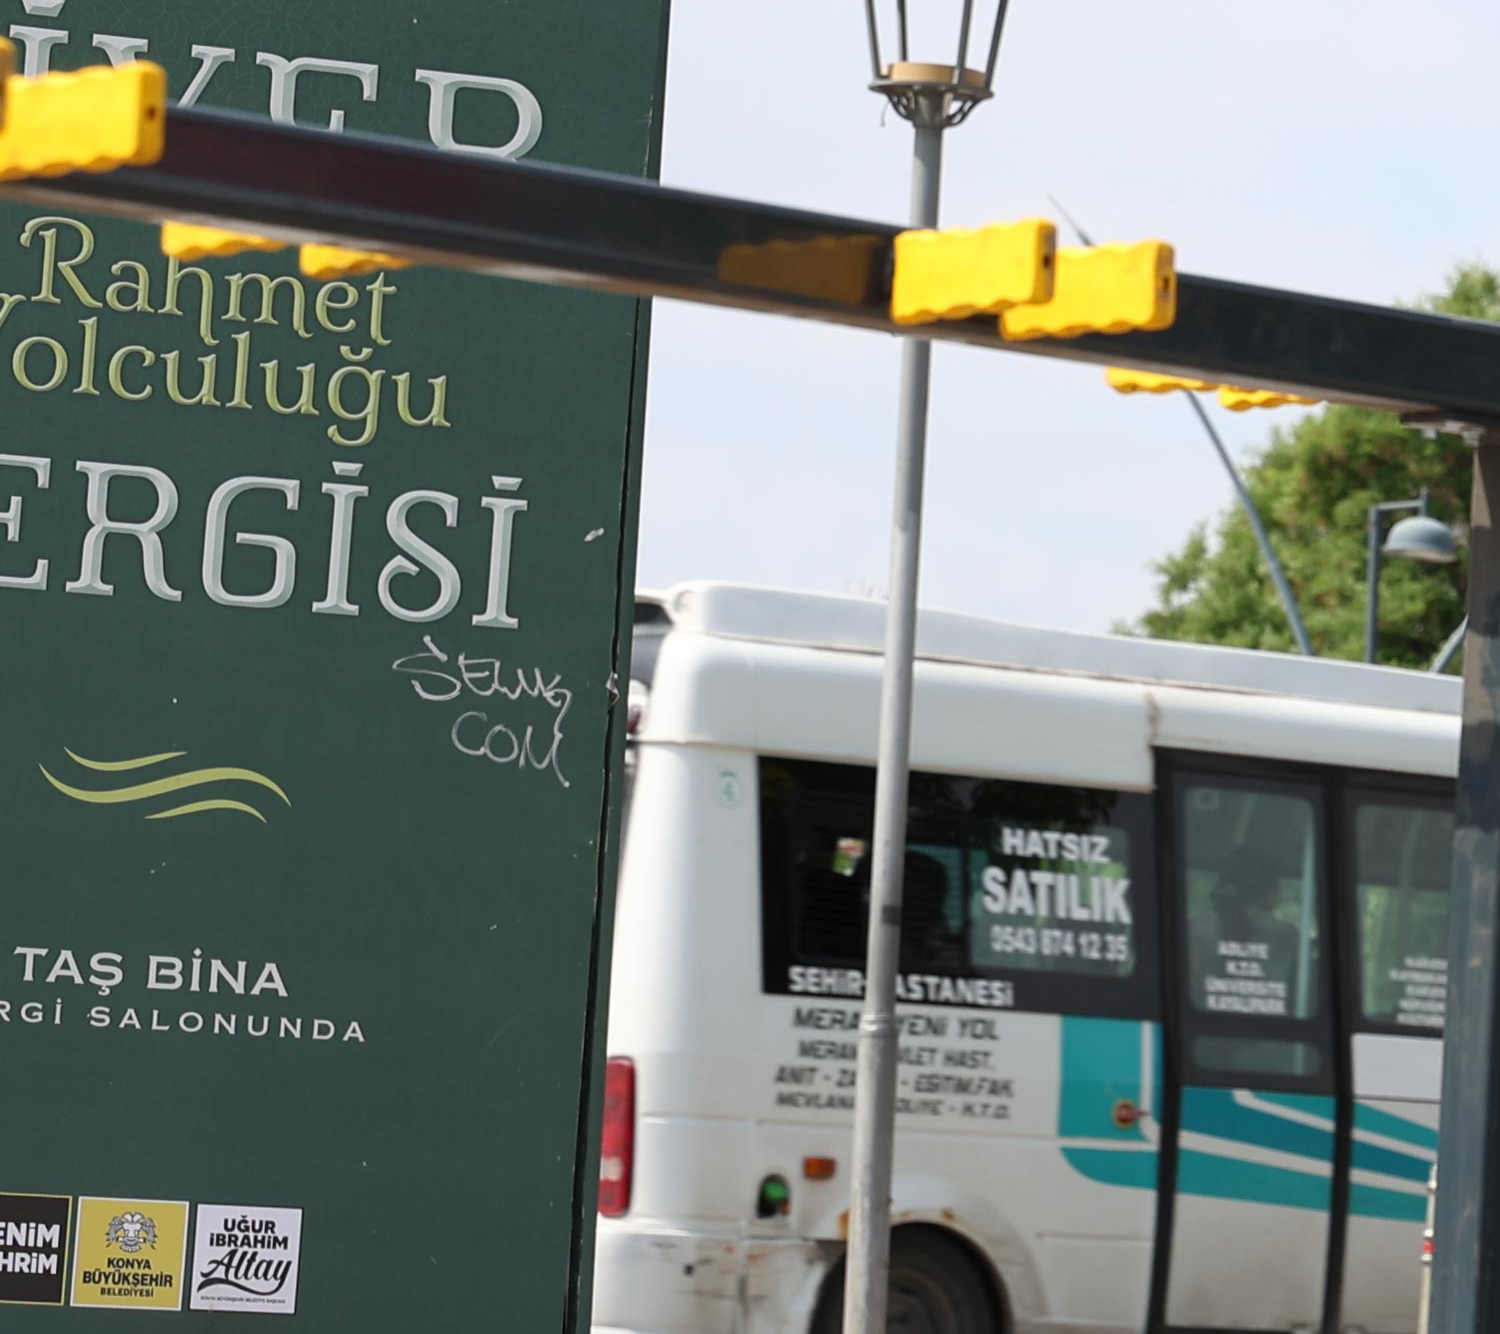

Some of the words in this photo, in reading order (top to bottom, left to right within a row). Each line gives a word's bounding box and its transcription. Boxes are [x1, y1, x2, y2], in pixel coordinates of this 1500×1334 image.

[20, 216, 397, 345] Rahmet
[981, 866, 1132, 924] SATILIK
[13, 946, 124, 996] TAŞ
[147, 947, 288, 997] BİNA
[89, 1005, 365, 1042] SALONUNDA
[223, 1214, 276, 1234] UĞUR
[209, 1232, 289, 1250] İBRAHİM
[82, 1267, 174, 1288] BÜYÜKŞEHİR
[107, 1257, 152, 1270] KONYA
[197, 1249, 293, 1296] Altay
[100, 1286, 155, 1298] BELEDİYESİ
